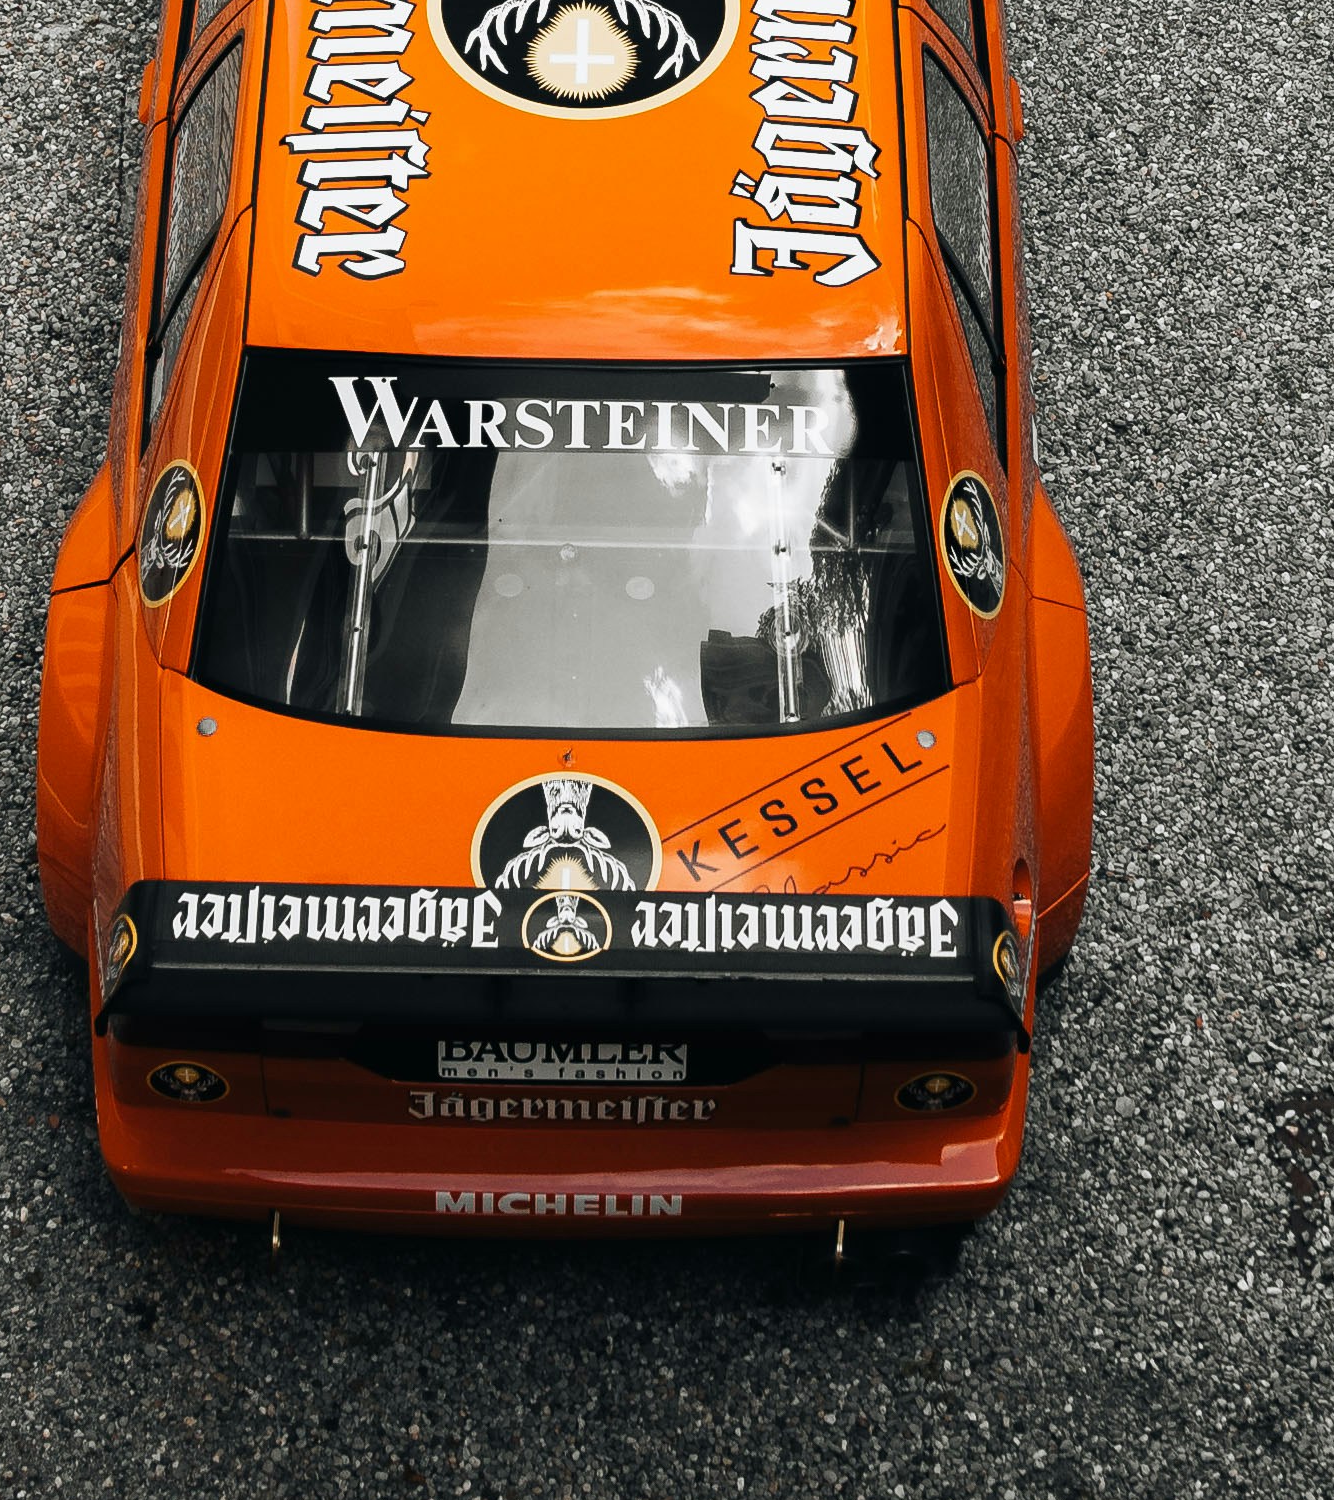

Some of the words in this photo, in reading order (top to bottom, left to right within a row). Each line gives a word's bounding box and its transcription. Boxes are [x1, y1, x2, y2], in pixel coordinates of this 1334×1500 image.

[328, 376, 841, 454] WARSTEINER
[676, 742, 923, 882] KESSEL
[441, 1066, 534, 1079] men's
[558, 1067, 684, 1081] fashion
[435, 1191, 683, 1217] MICHELIN
